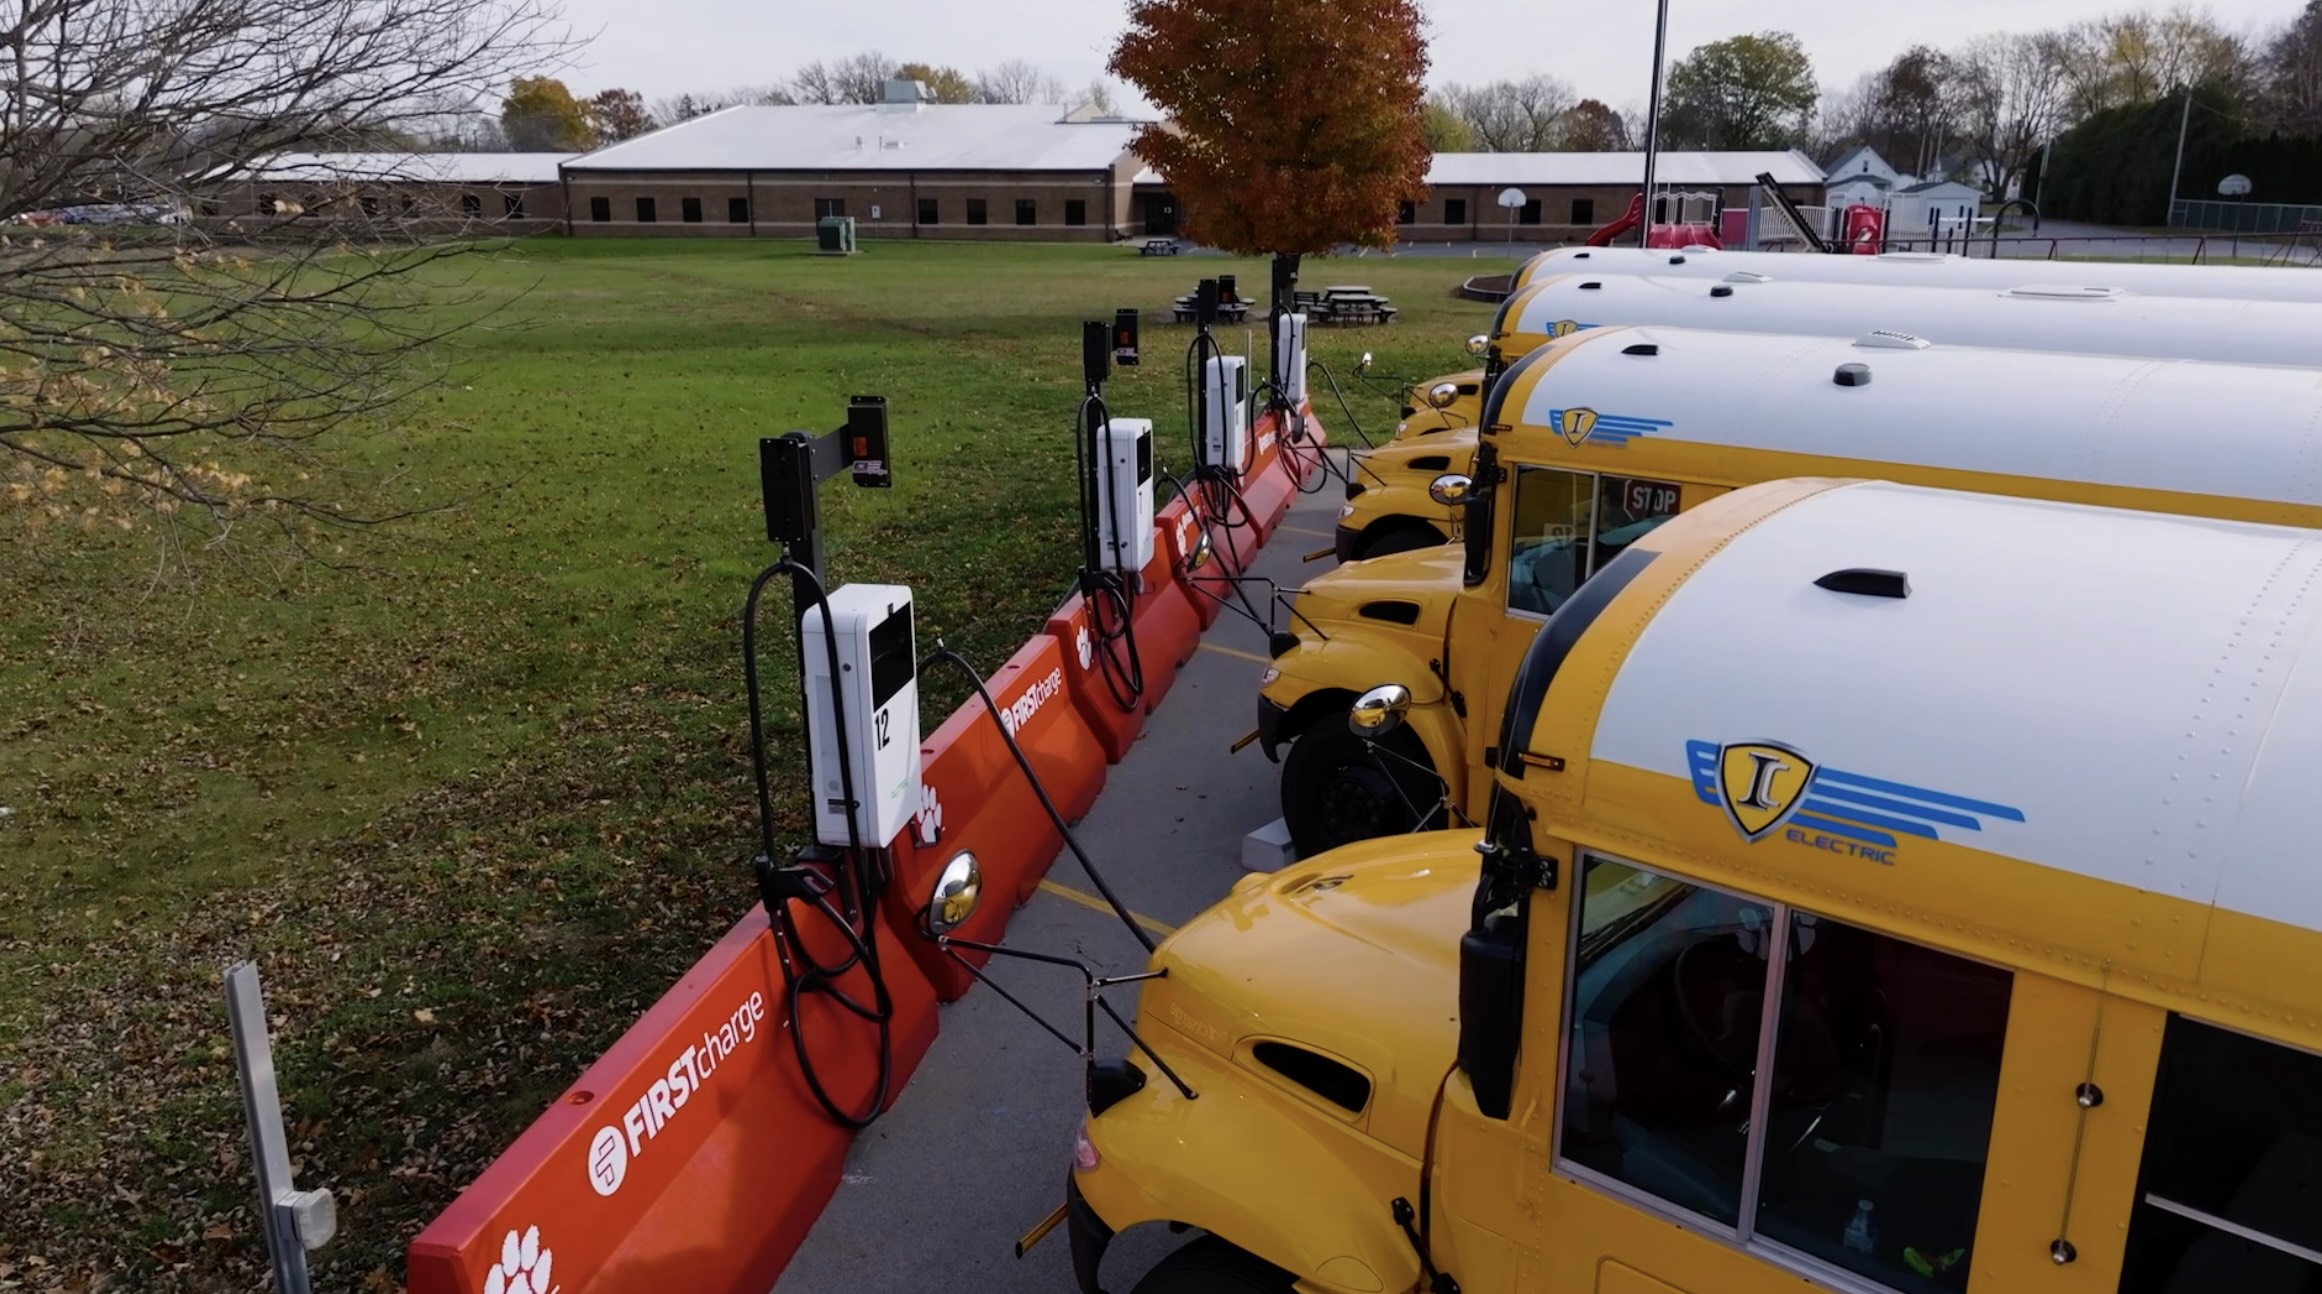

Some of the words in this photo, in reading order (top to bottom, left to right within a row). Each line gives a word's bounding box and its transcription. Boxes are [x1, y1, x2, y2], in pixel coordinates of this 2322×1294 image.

[1632, 487, 1676, 512] STOP
[1012, 667, 1062, 731] FIRSTcharge
[874, 707, 891, 752] 12
[1785, 828, 1897, 866] ELECTRIC
[623, 991, 764, 1157] FIRSTcharge
